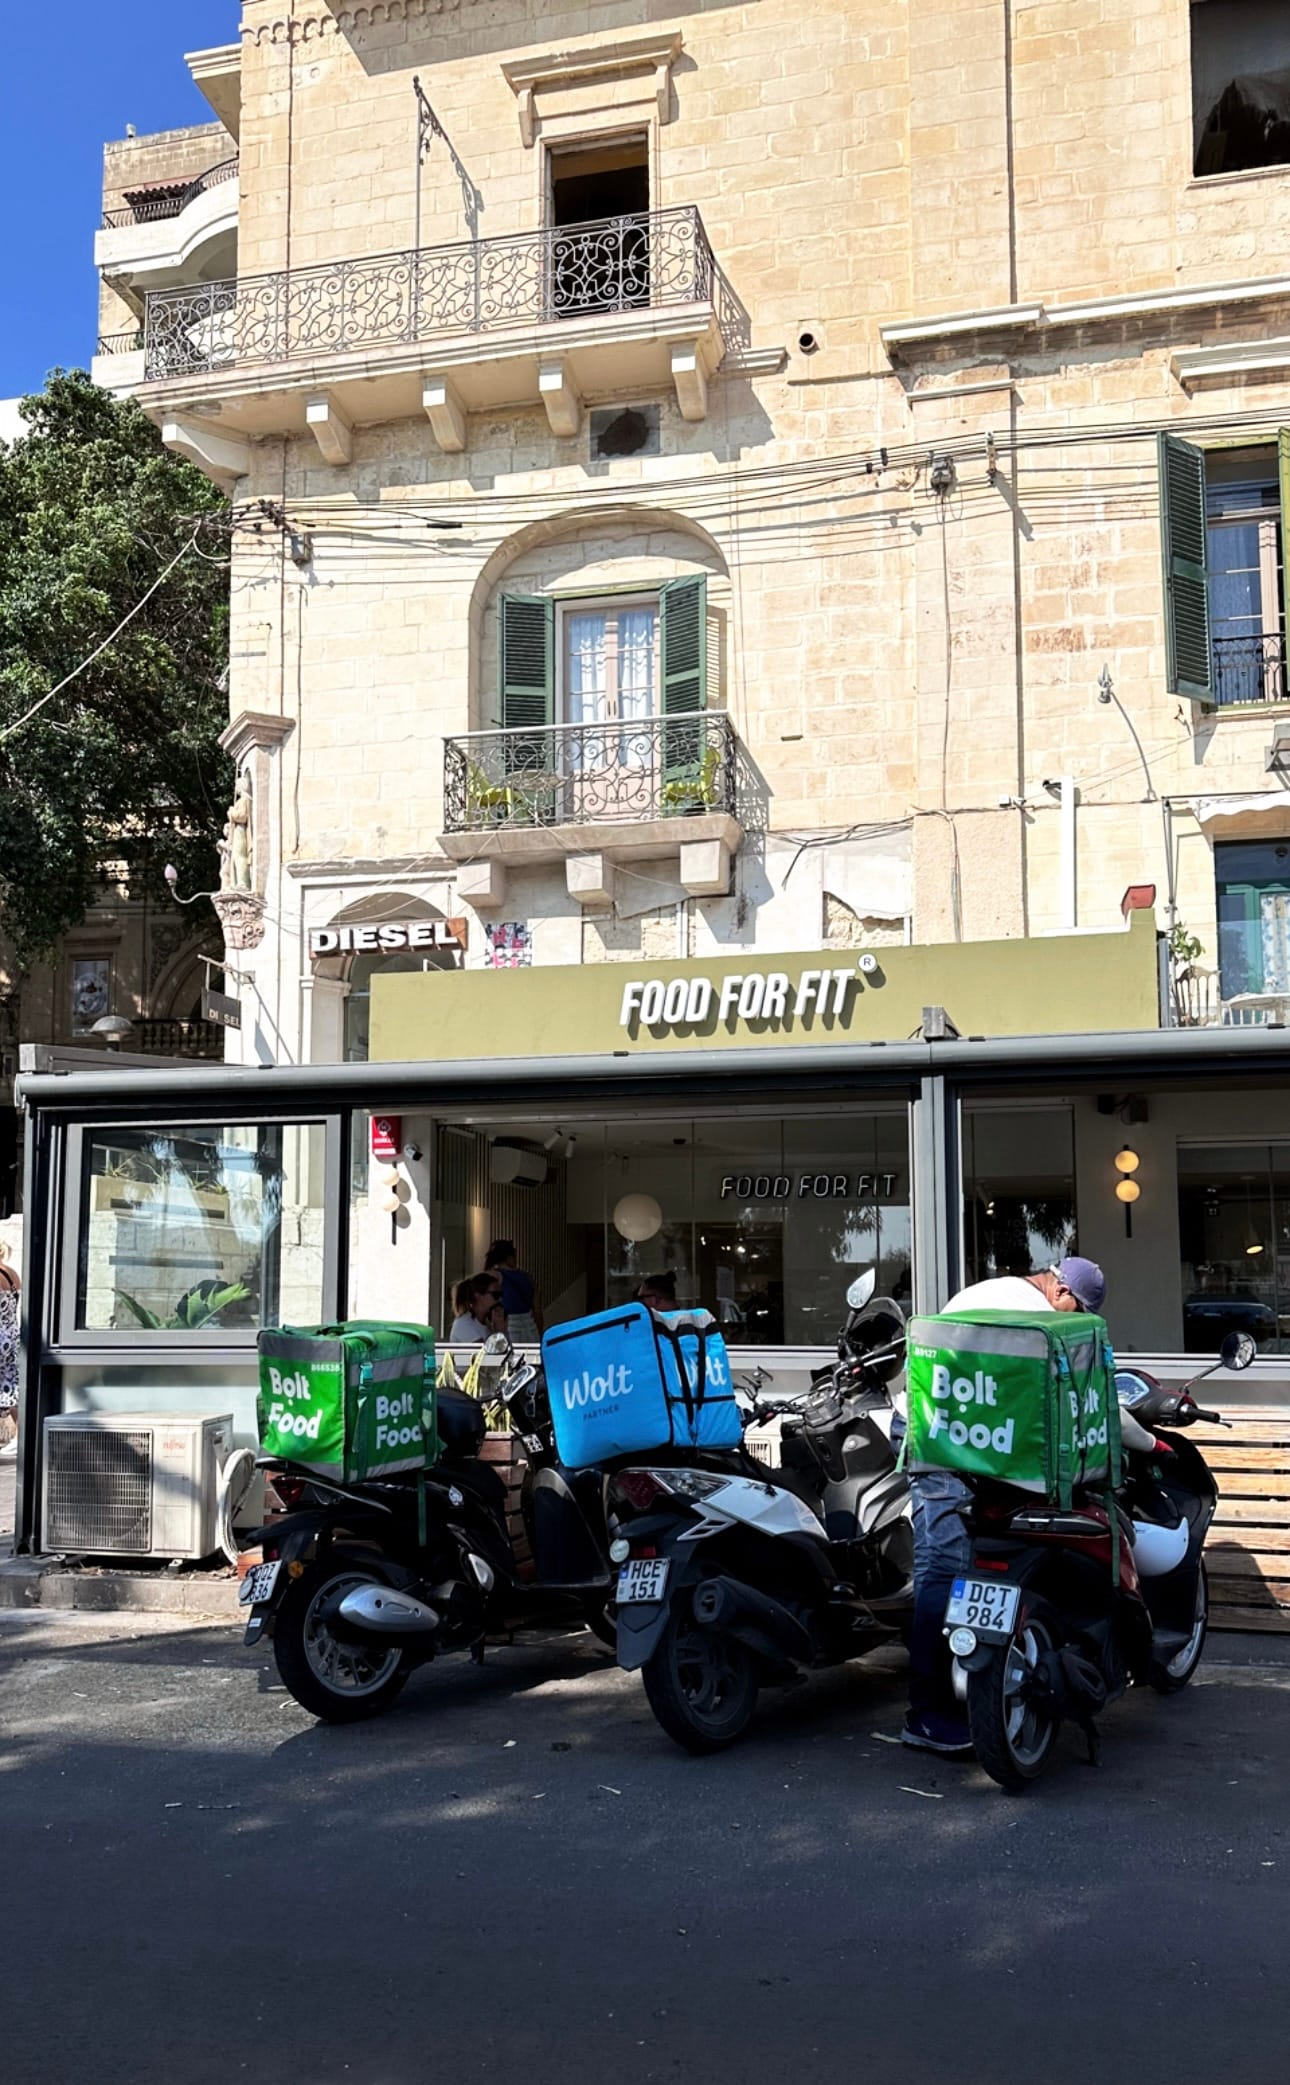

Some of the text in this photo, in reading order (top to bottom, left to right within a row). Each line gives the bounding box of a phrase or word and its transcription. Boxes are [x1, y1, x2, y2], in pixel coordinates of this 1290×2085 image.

[311, 922, 457, 951] DIESEL
[619, 977, 712, 1026] FOOD
[718, 973, 789, 1020] FOR
[794, 968, 856, 1016] FIT
[721, 1174, 896, 1198] FOOD FOR FIT
[269, 1366, 312, 1402] Bolt
[564, 1363, 634, 1410] Wolt
[931, 1364, 998, 1409] Bolt
[376, 1392, 414, 1421] Bolt
[583, 1403, 620, 1421] PARTNER
[1068, 1387, 1100, 1419] Blt
[269, 1402, 324, 1440] Food
[928, 1407, 1015, 1455] Food
[631, 1561, 663, 1580] HCE
[628, 1580, 657, 1600] 151
[968, 1583, 1012, 1607] DCT
[967, 1605, 1006, 1630] 984
